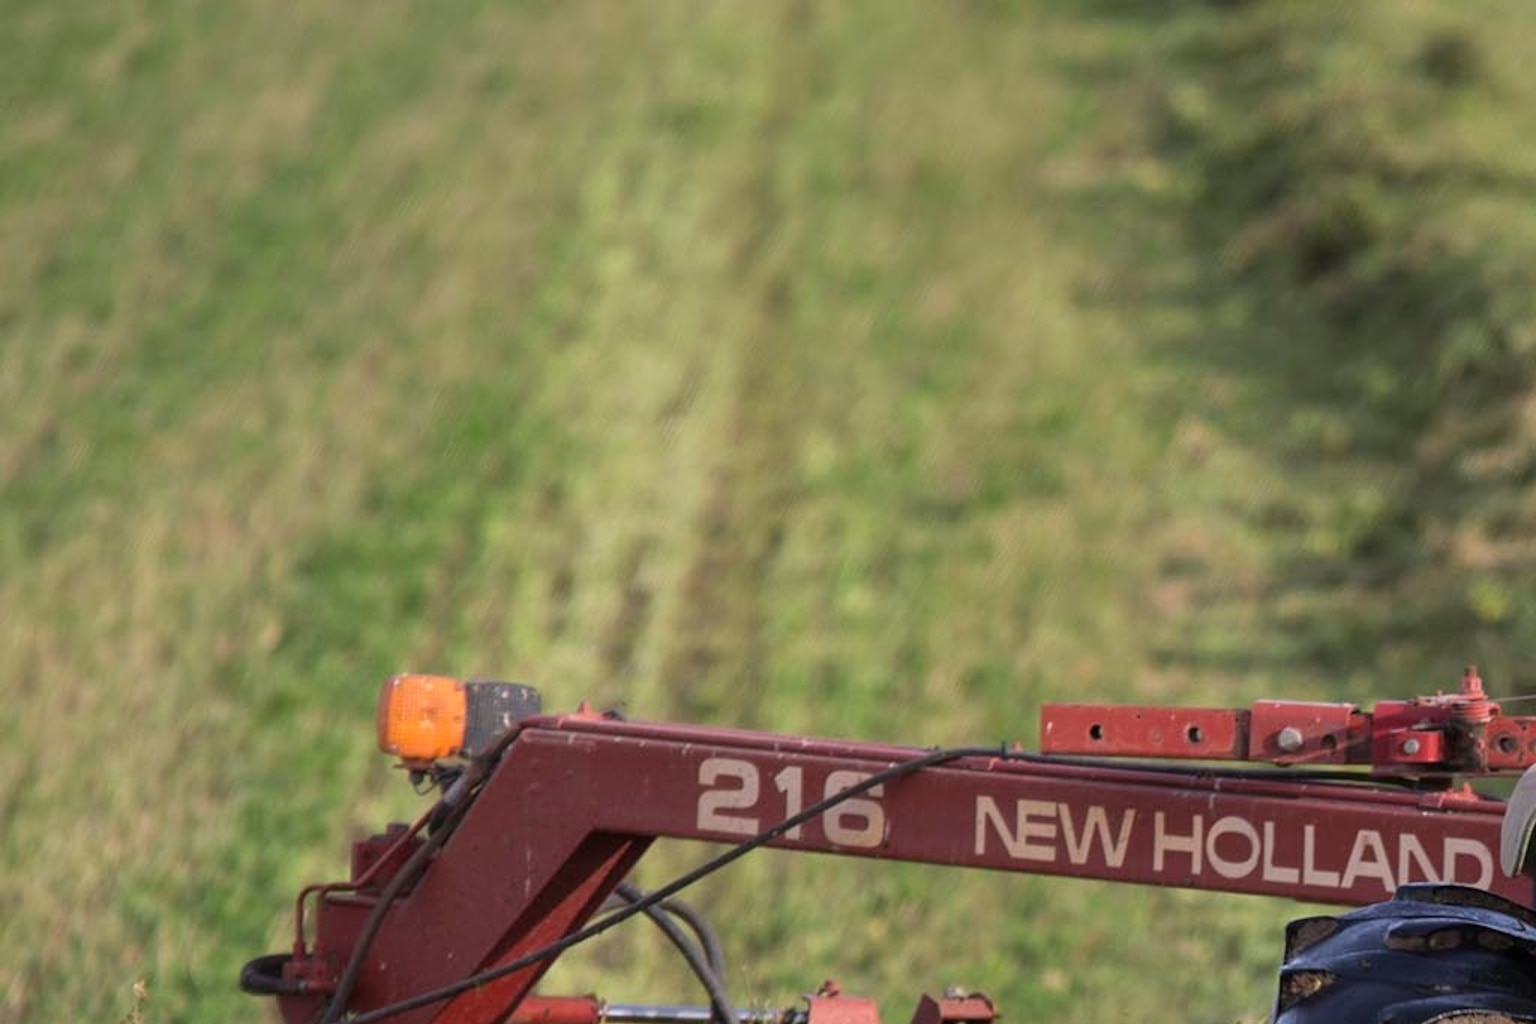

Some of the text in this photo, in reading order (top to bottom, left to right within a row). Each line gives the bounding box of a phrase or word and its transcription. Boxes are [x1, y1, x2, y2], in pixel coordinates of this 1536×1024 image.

[696, 757, 886, 848] 216
[974, 795, 1494, 892] NEW HOLLAND
